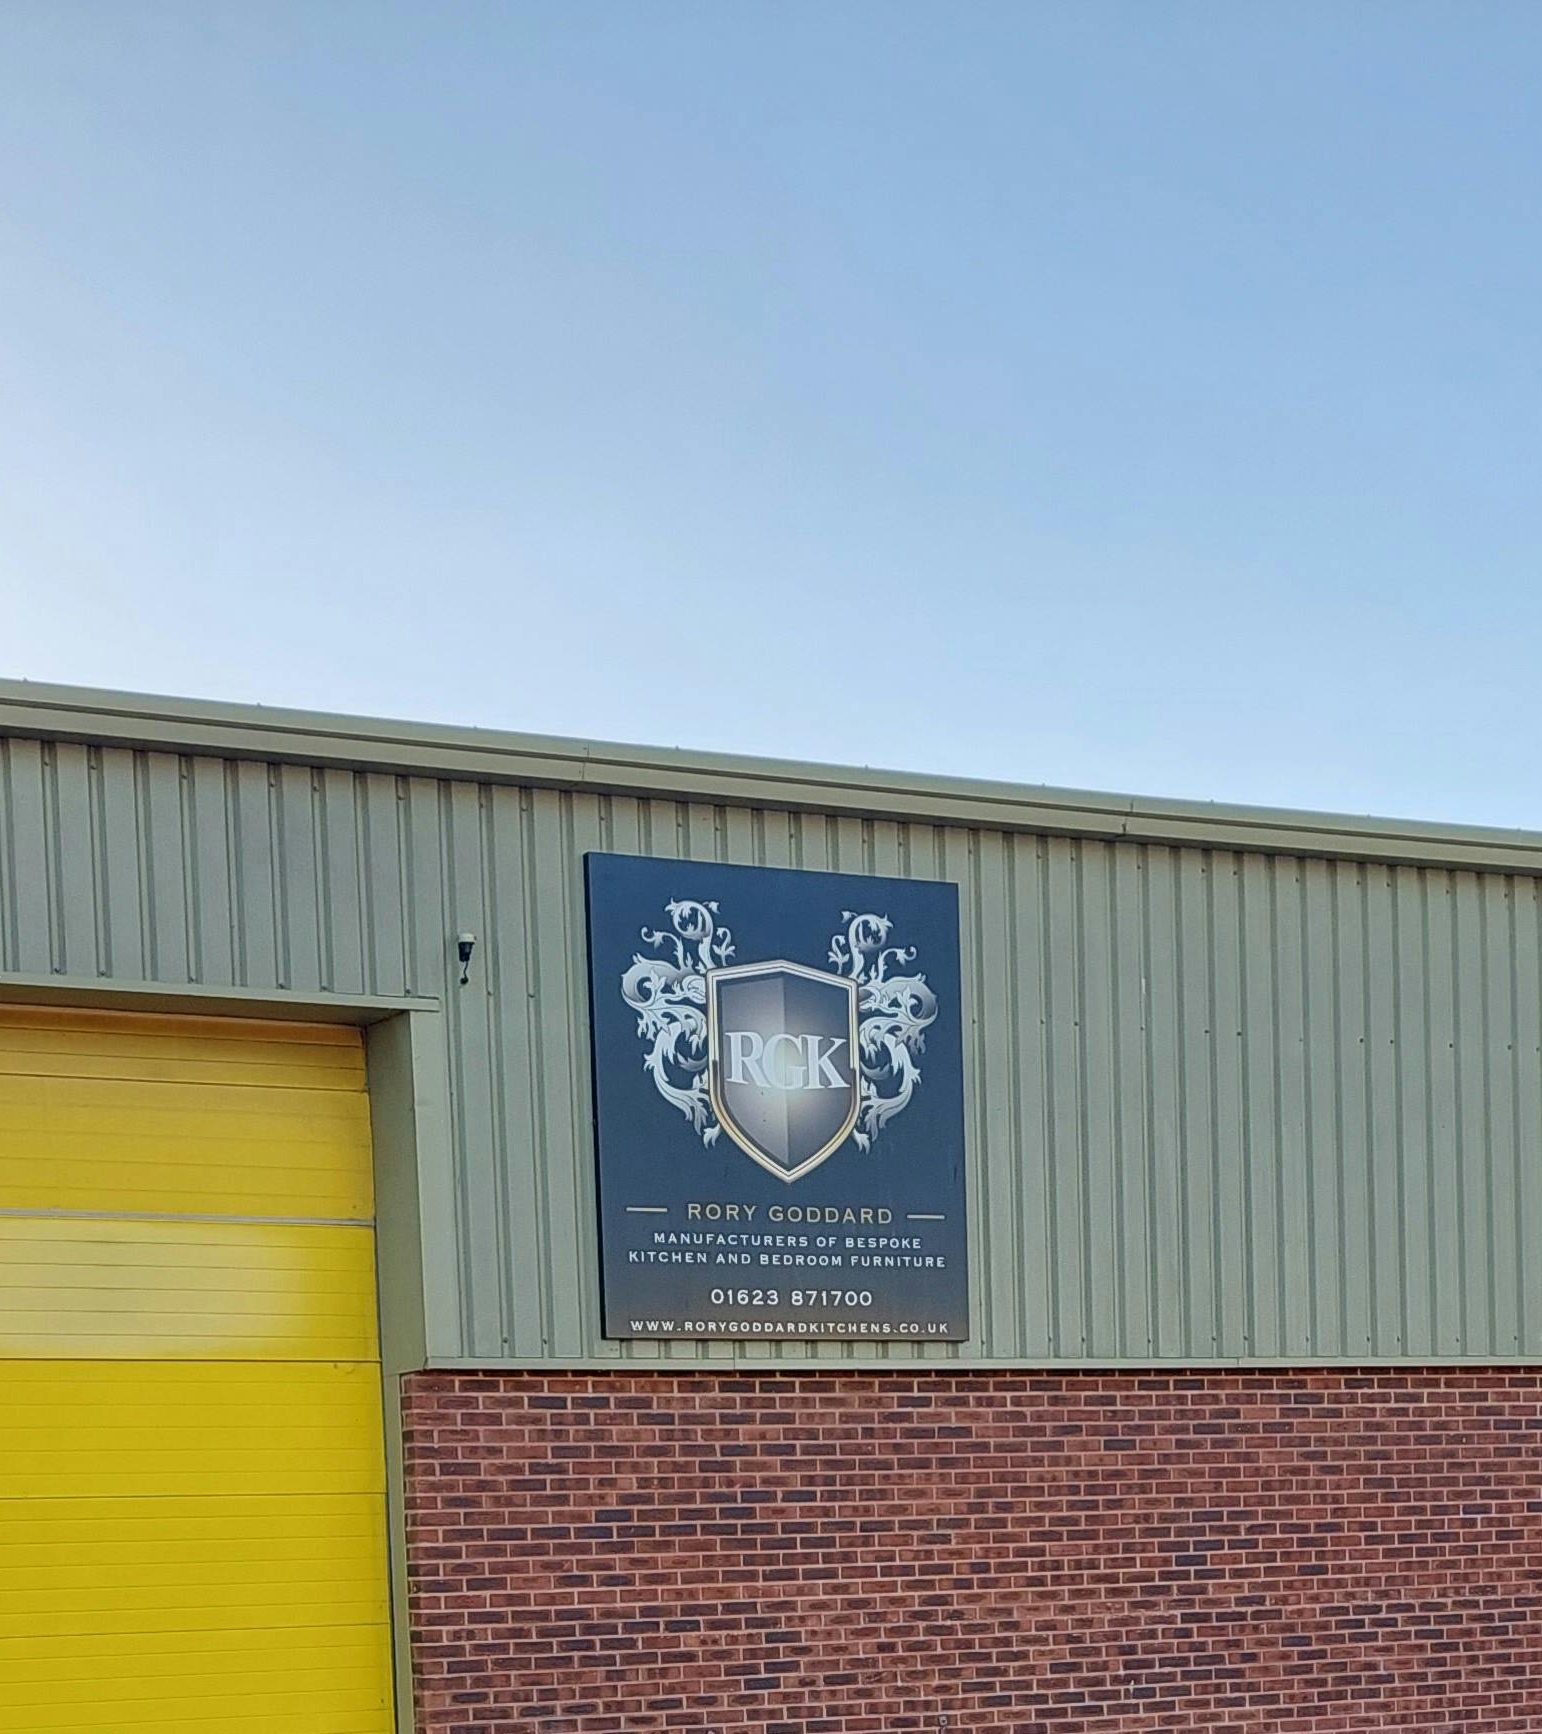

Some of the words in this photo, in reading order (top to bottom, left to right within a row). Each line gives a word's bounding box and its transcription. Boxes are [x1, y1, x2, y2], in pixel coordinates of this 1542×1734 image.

[725, 1031, 849, 1089] RGK
[687, 1203, 758, 1221] RORY
[768, 1206, 893, 1224] GODDARD
[654, 1232, 808, 1247] MANUFACTURERS
[816, 1236, 838, 1248] OF
[845, 1236, 922, 1249] BESPOKE
[628, 1251, 707, 1264] KITCHEN
[715, 1253, 752, 1265] AND
[759, 1254, 842, 1267] BEDROOM
[850, 1255, 946, 1268] FURNITURE
[711, 1288, 779, 1306] 01623
[791, 1290, 873, 1307] 871700
[630, 1320, 949, 1334] WWW.RORYGODDARDKITCHENS.CO.UK
